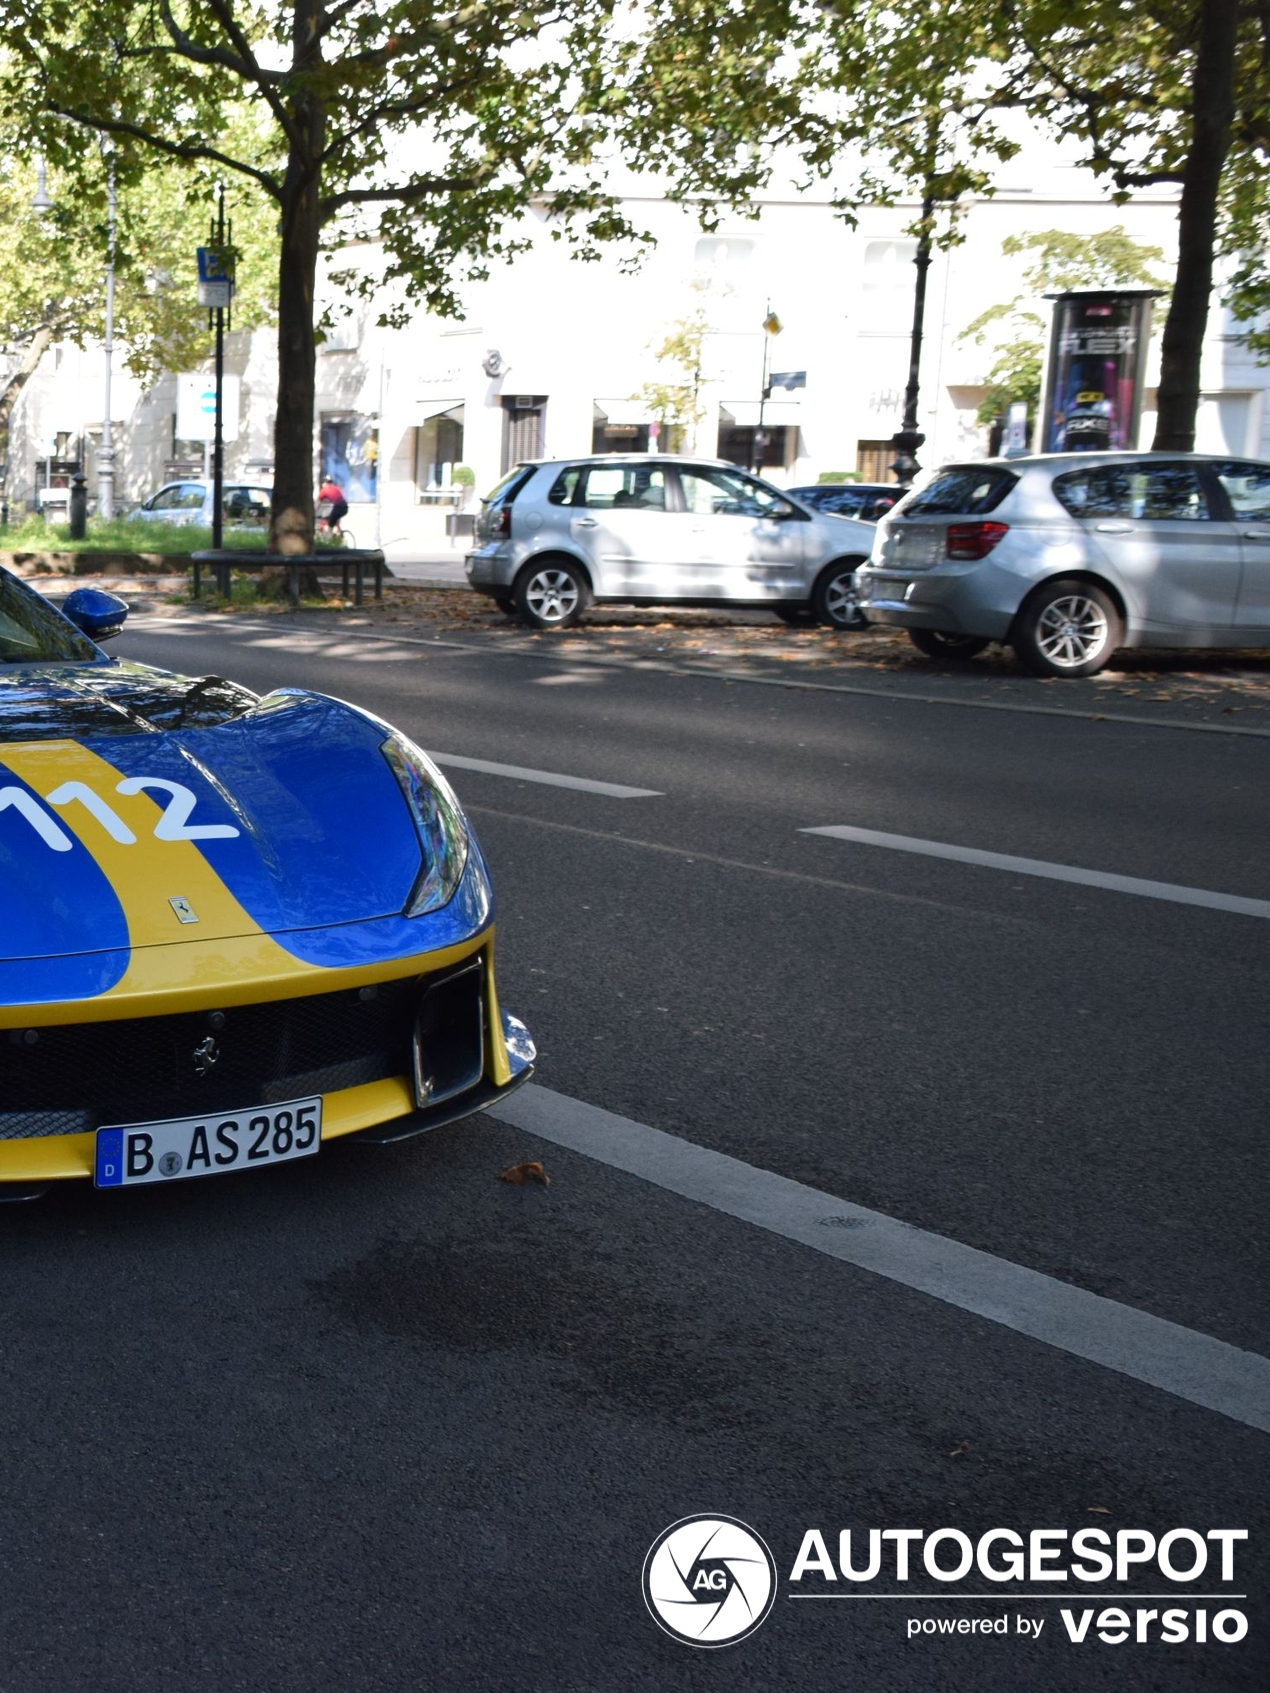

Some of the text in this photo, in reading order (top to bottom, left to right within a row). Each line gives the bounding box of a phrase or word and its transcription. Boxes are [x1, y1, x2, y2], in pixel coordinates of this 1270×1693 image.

[1059, 338, 1137, 355] FLEX
[127, 1105, 316, 1177] B AS 285
[104, 1163, 115, 1177] D
